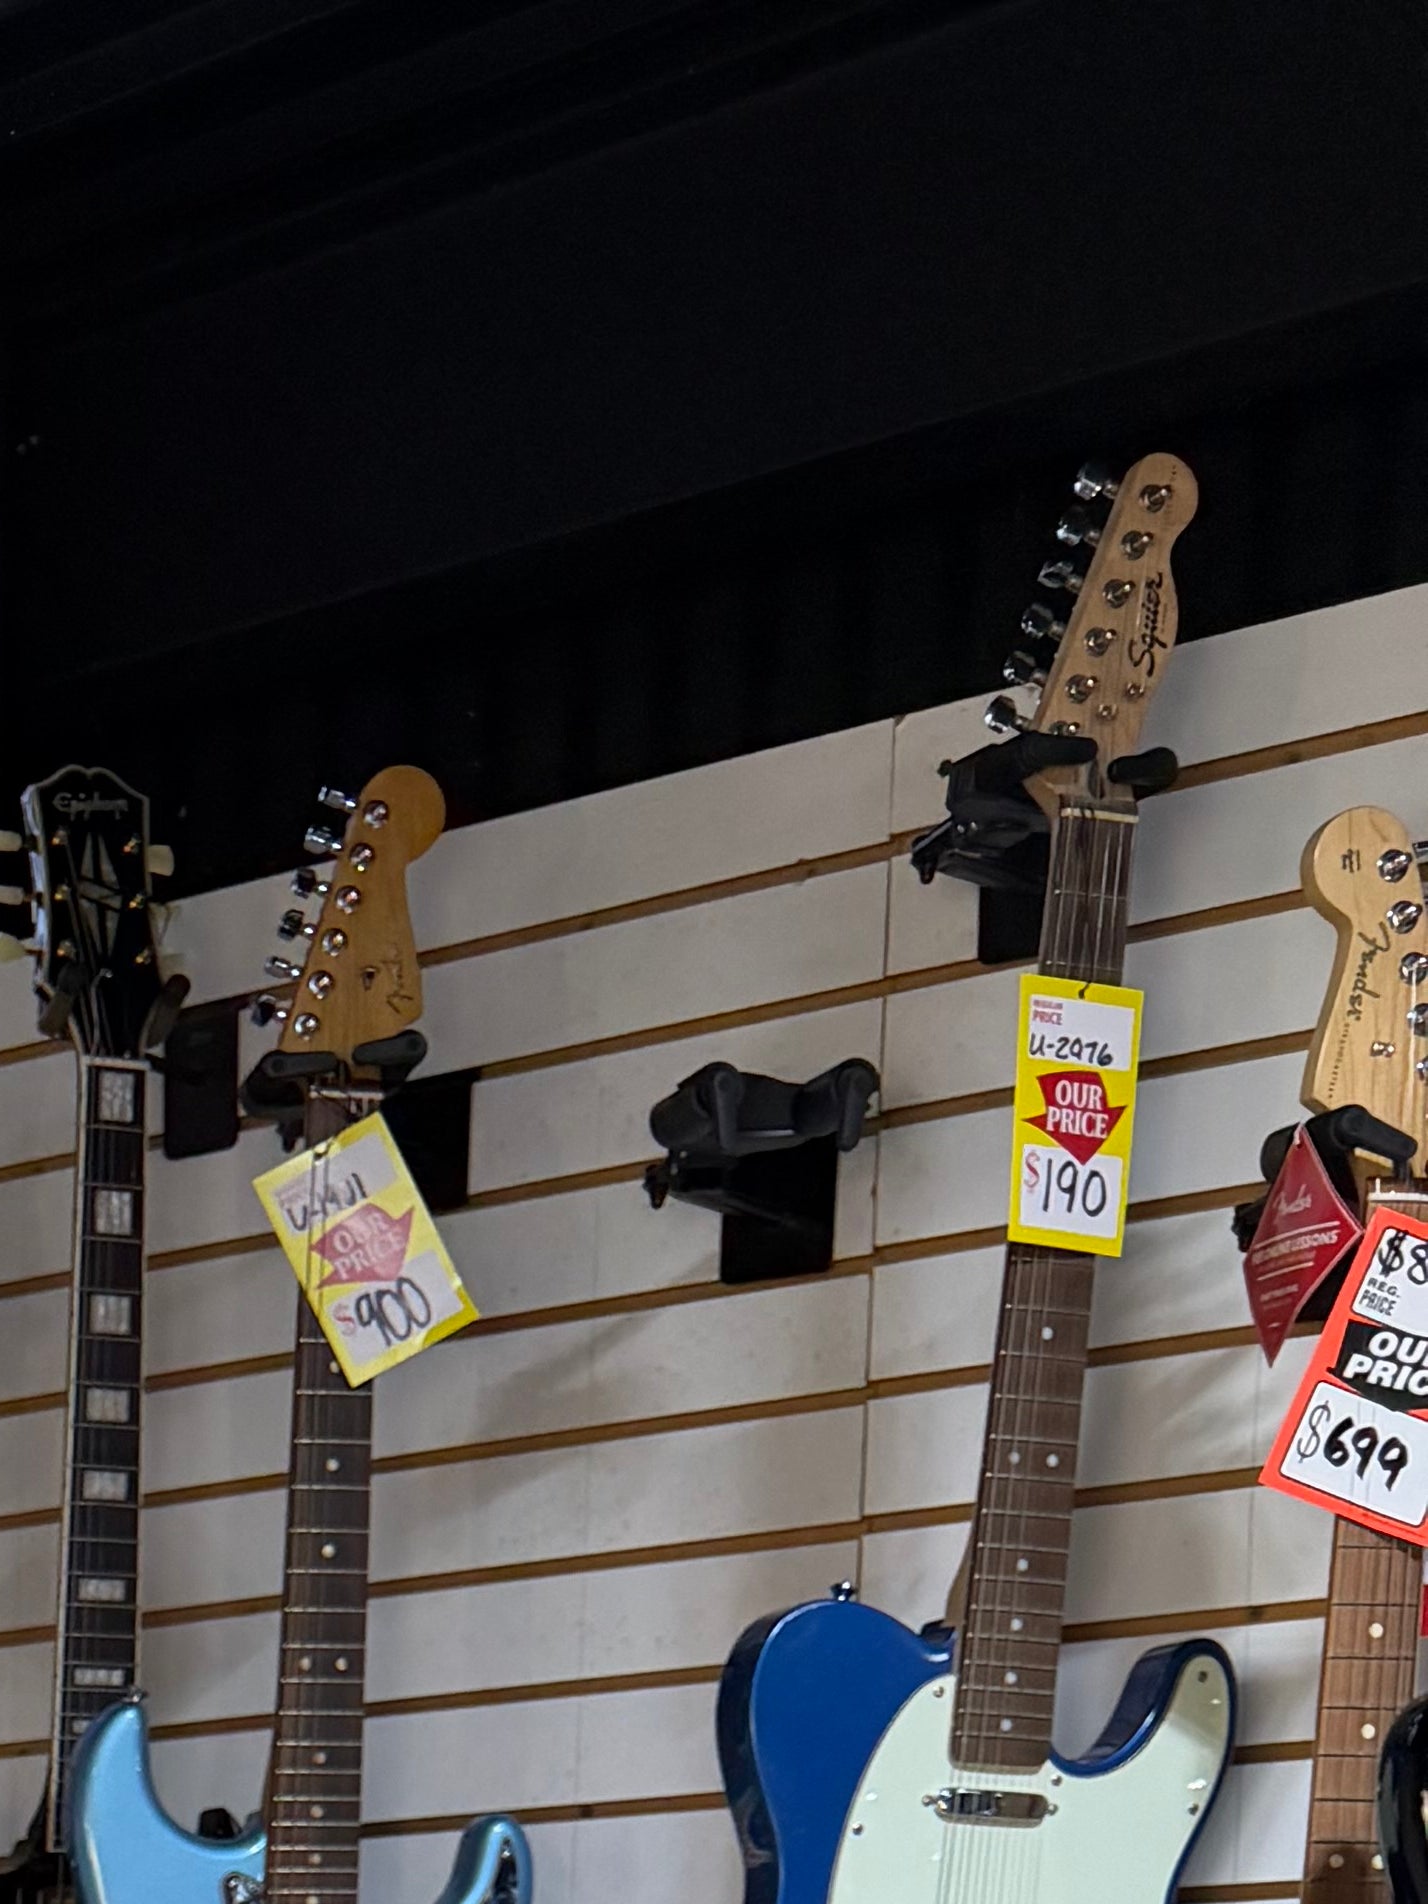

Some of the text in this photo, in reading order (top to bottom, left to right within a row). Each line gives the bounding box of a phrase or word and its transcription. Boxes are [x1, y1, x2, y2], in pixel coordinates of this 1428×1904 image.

[1129, 572, 1168, 677] Squier
[1346, 921, 1391, 1023] Fender
[1055, 1080, 1104, 1111] OUR
[1046, 1105, 1109, 1139] PRICE
[332, 1210, 391, 1253] OUR
[334, 1232, 406, 1280] PRICE
[1366, 1277, 1401, 1299] REG.
[1367, 1331, 1428, 1365] OU
[1343, 1353, 1428, 1396] PRIC
[1297, 1399, 1409, 1492] $699
